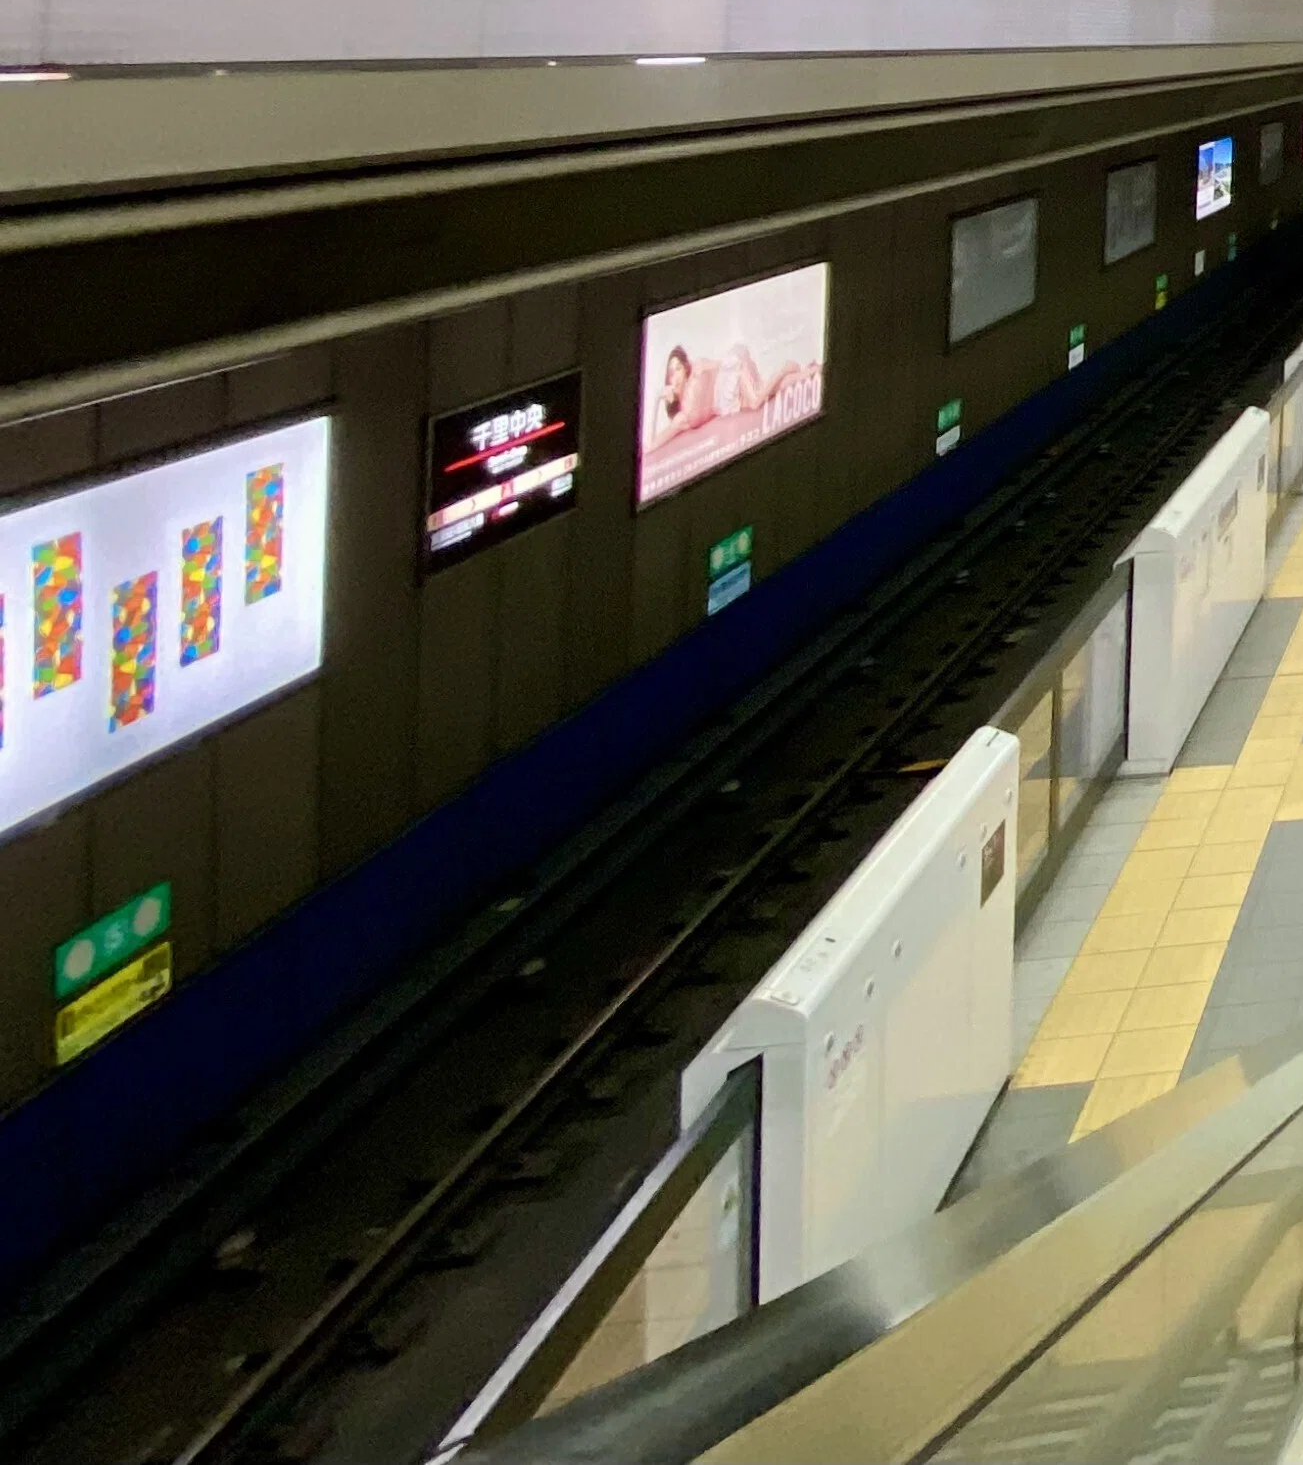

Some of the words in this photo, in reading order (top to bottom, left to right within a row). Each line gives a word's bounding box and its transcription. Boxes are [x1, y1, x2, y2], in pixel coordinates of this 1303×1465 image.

[470, 403, 546, 451] 千里中央
[761, 373, 822, 436] LACOCO
